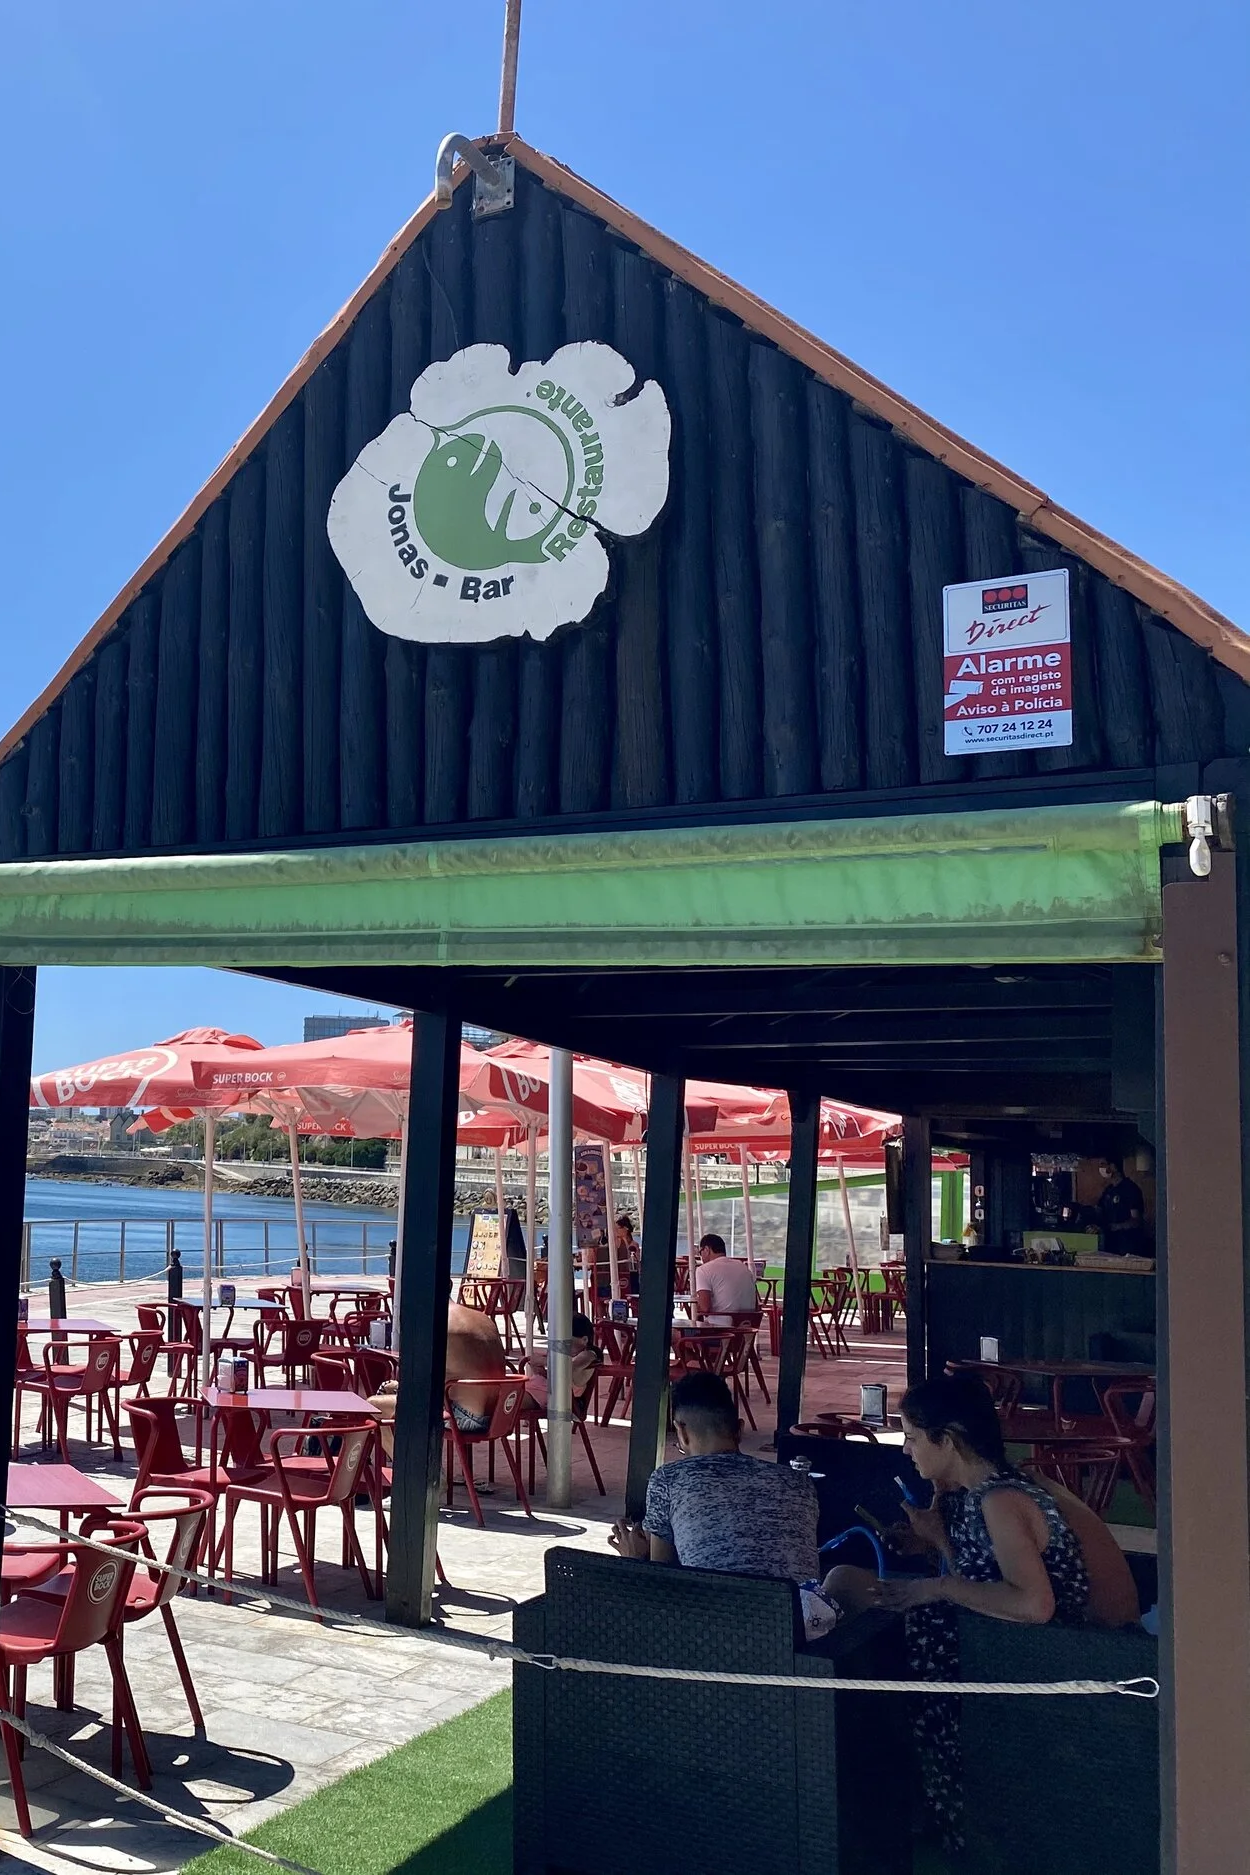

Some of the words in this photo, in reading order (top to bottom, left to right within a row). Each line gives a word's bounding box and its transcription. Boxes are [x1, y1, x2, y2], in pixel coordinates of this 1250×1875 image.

[536, 380, 605, 562] Restaurante
[388, 483, 429, 580] Jonas
[460, 575, 515, 601] Bar
[983, 600, 1027, 612] SECURITAS
[964, 604, 1052, 645] Direct
[956, 652, 1062, 677] Alarme
[990, 675, 1016, 686] com
[1019, 670, 1062, 685] registo
[990, 684, 1007, 696] de
[1010, 681, 1062, 695] imagens
[956, 703, 997, 717] Aviso
[1001, 701, 1010, 713] à
[1014, 698, 1063, 711] Polícia
[977, 724, 999, 735] 707
[1001, 722, 1017, 733] 24
[1020, 720, 1035, 731] 12
[1037, 718, 1053, 729] 24
[964, 731, 1054, 744] www.securitasdirect.pt
[54, 1057, 157, 1079] SUPER
[55, 1067, 144, 1104] BOCK
[212, 1073, 243, 1085] SUPER
[244, 1072, 273, 1083] BOCK
[94, 1580, 111, 1591] BOCK
